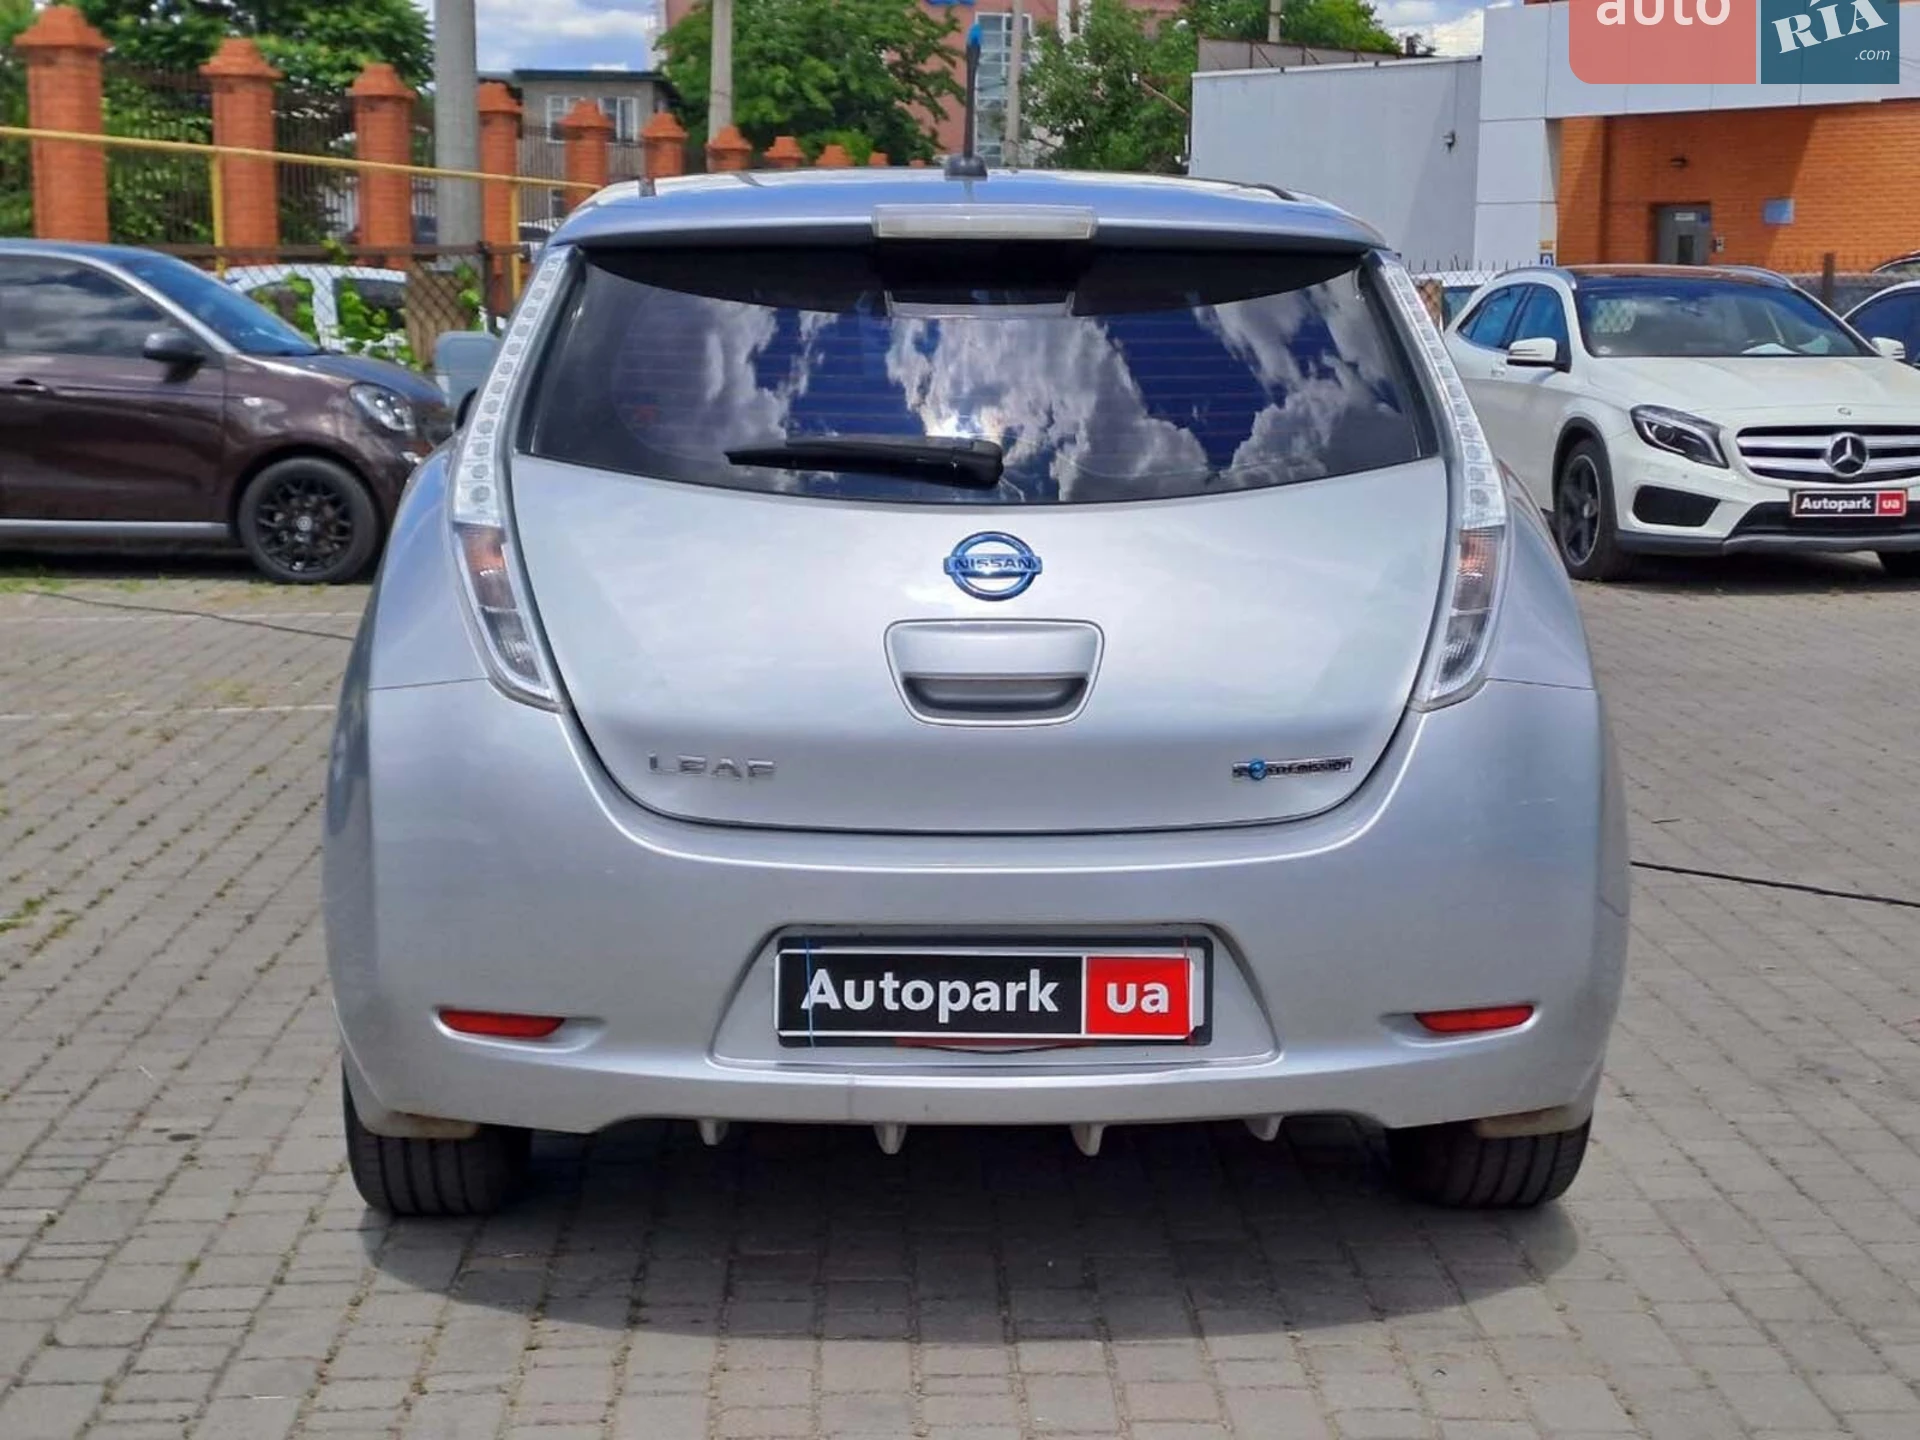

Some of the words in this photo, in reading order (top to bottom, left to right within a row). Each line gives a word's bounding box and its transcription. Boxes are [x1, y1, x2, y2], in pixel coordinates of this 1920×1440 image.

[1800, 497, 1871, 512] Autopark
[1882, 500, 1900, 509] ua
[954, 558, 1032, 569] NISSAN
[648, 752, 775, 778] LEAF
[801, 968, 1059, 1023] Autopark
[1106, 981, 1169, 1014] ua
